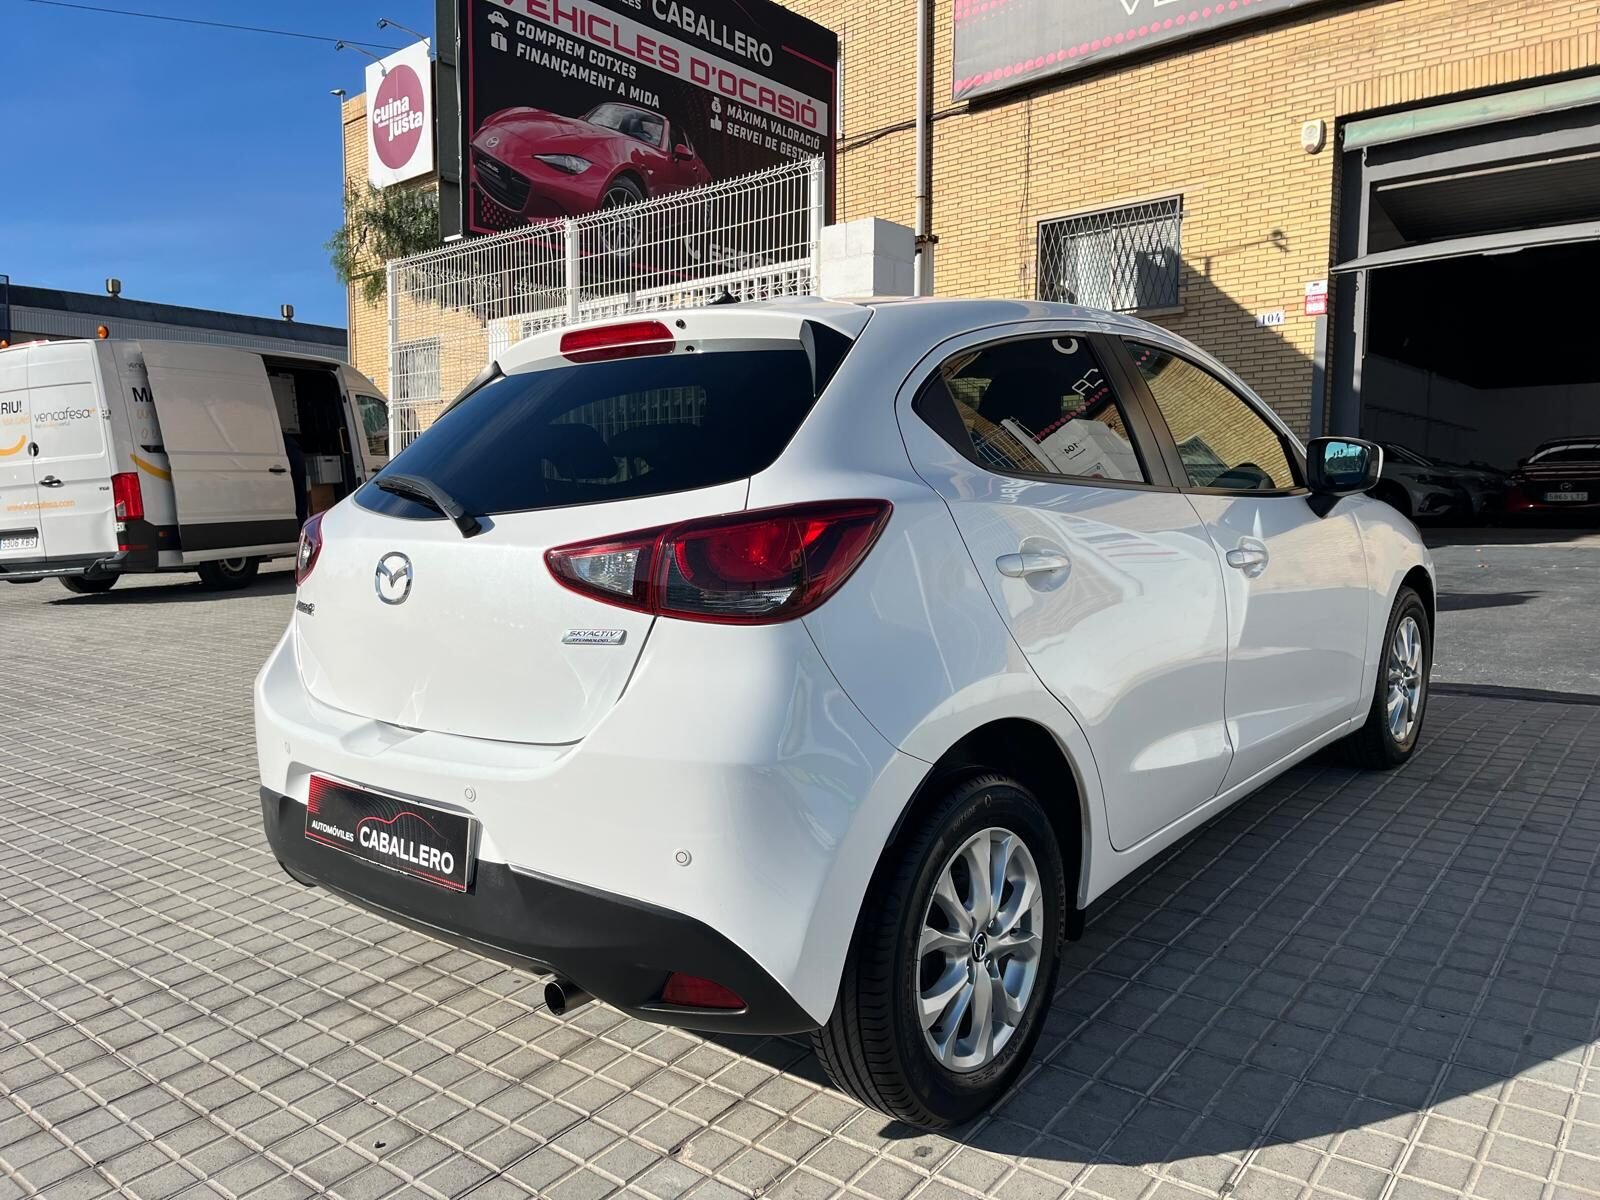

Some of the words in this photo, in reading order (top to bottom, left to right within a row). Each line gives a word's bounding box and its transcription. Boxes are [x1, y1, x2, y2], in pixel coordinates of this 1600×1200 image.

[516, 20, 585, 60] COMPREM
[588, 50, 637, 80] COTXES
[652, 0, 774, 67] CABALLERO
[503, 0, 680, 74] EHICLES
[690, 56, 817, 129] D'OCASIÓ
[516, 43, 615, 91] FINANÇAMENT
[617, 81, 626, 96] A
[629, 85, 660, 109] MIDA
[373, 96, 410, 124] cuina
[388, 110, 423, 142] justa
[727, 104, 768, 131] MÀXIMA
[770, 120, 820, 150] VALORACIÓ
[727, 122, 763, 145] SERVEI
[765, 136, 777, 151] DE
[1262, 313, 1281, 325] 104
[1, 400, 22, 415] RIU!
[34, 407, 91, 422] vencafesa
[311, 820, 355, 842] AUTOMÓVILES
[359, 826, 455, 874] CABALLERO
